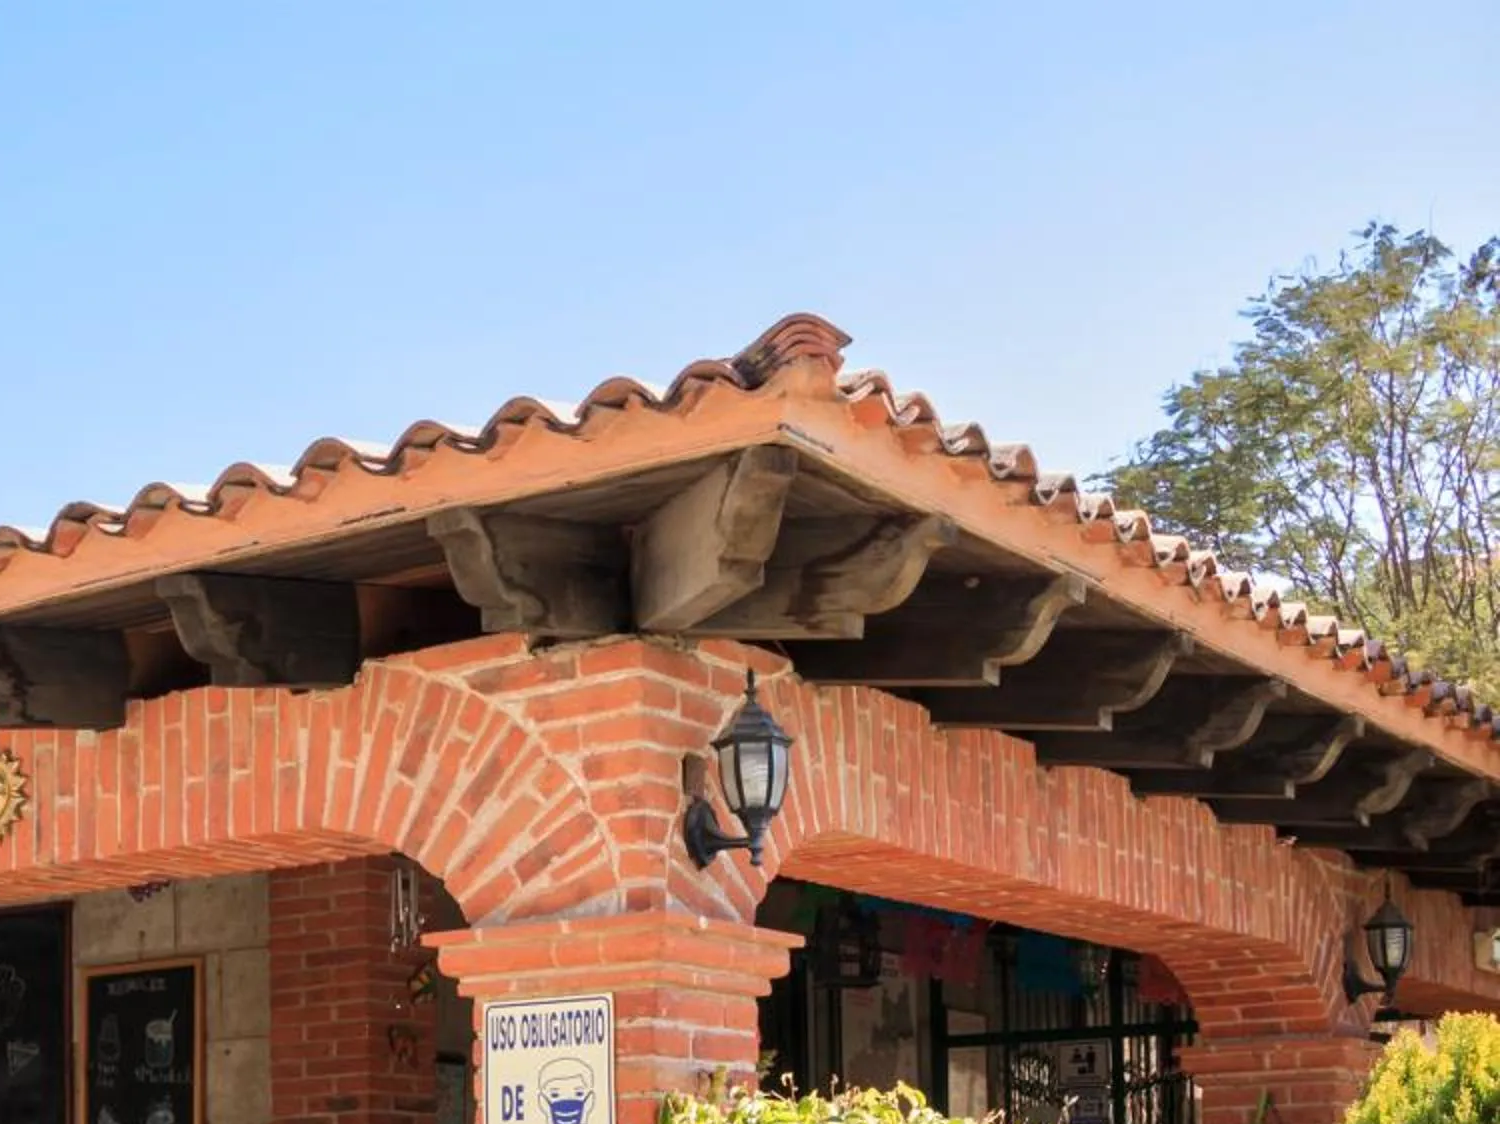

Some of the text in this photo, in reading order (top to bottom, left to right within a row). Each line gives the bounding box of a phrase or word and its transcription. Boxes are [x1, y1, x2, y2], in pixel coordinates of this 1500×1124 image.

[491, 1009, 605, 1050] USO OBLIGATORIO
[501, 1085, 525, 1122] DE
